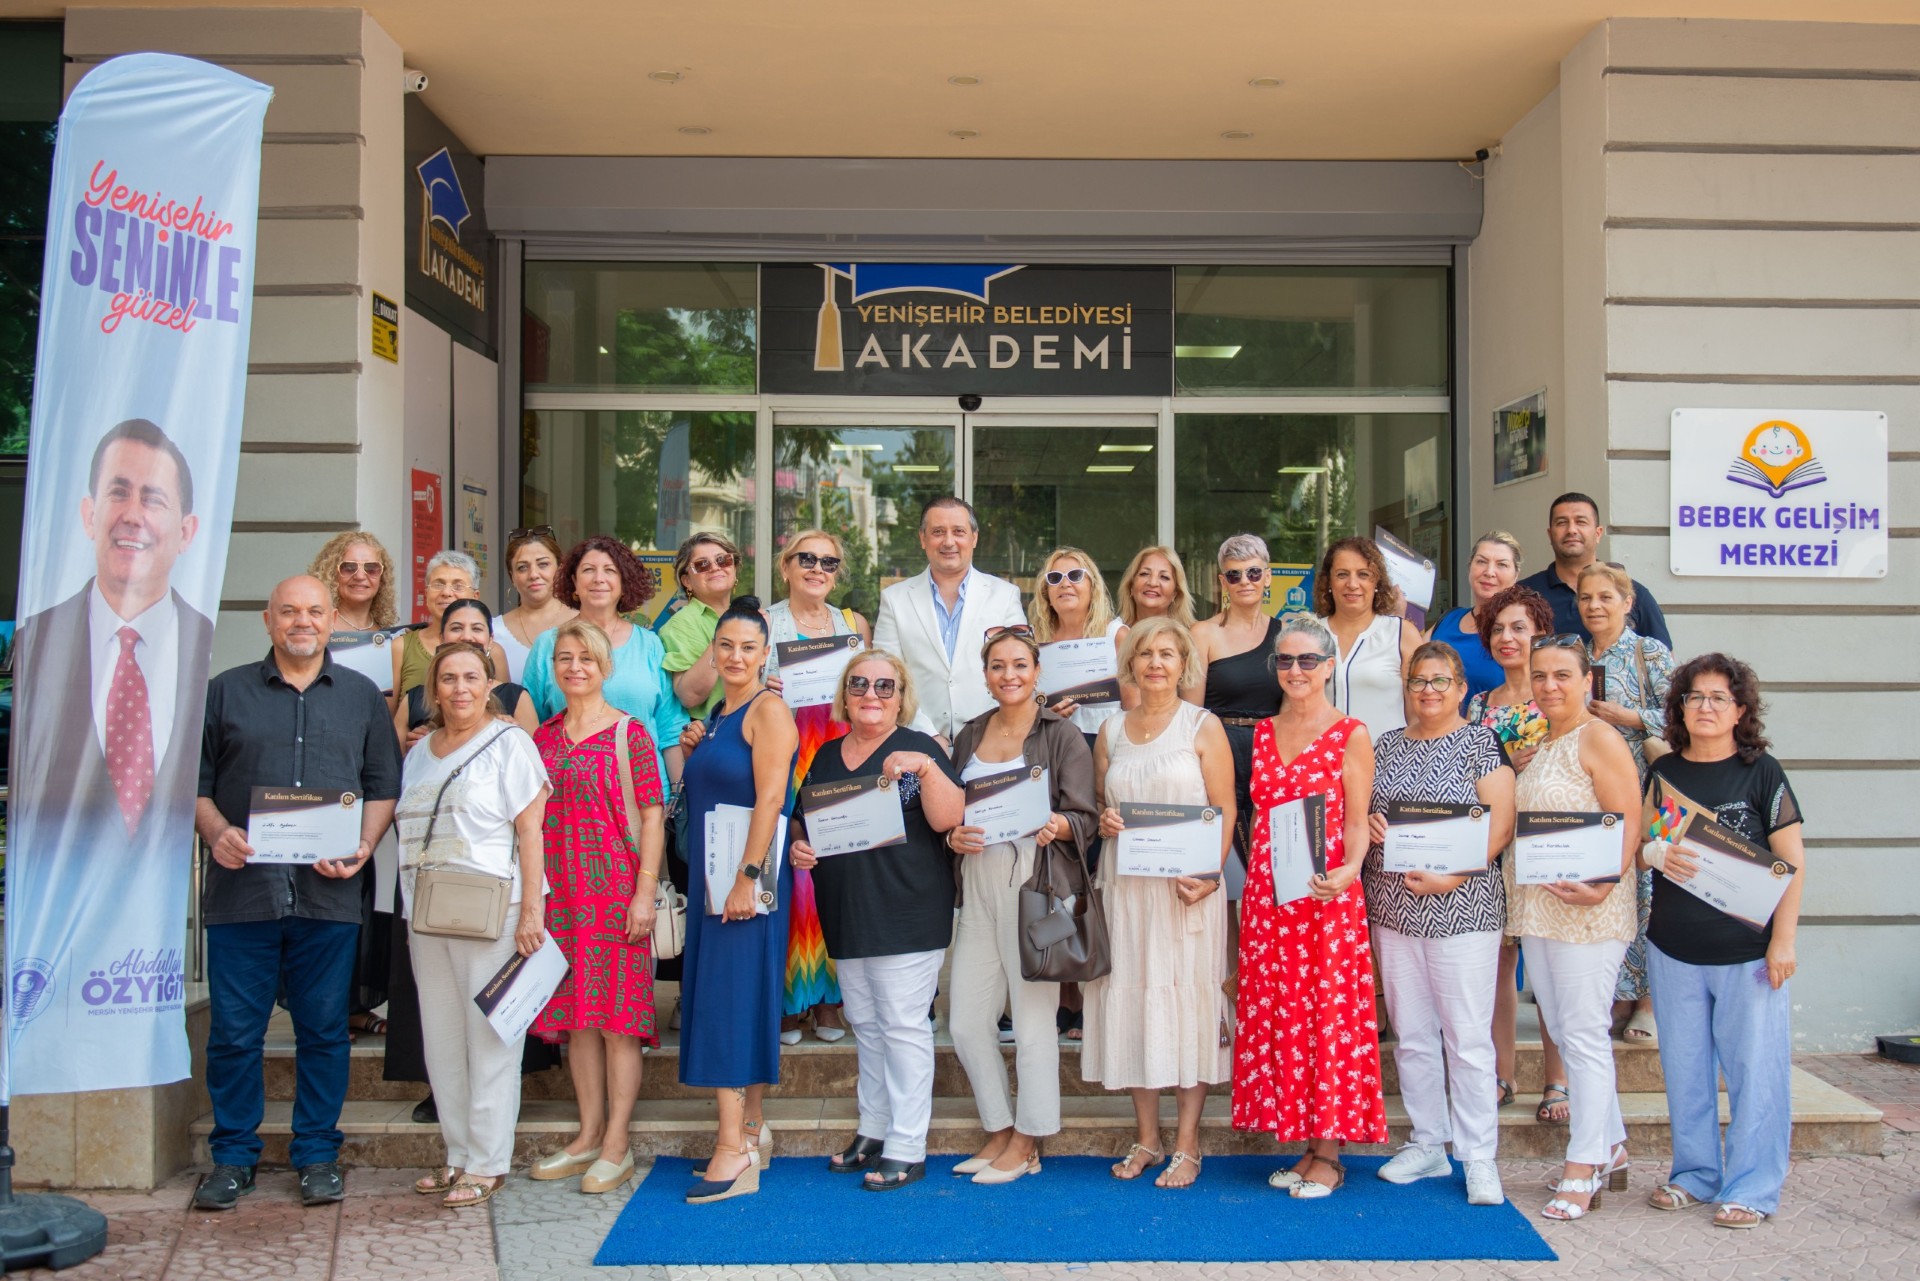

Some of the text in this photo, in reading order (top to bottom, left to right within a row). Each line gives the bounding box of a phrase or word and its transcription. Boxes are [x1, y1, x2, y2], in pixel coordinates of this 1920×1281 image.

[431, 249, 485, 312] AKADEMİ
[101, 289, 198, 334] güzel
[858, 302, 1132, 327] YENİŞEHİR BELEDİYESİ
[855, 327, 1132, 370] AKADEMİ
[1678, 502, 1880, 534] BEBEK GELİŞİM
[1720, 540, 1838, 566] MERKEZİ
[264, 792, 324, 802] Katılım Sertifikası
[811, 784, 863, 798] Katılım Sertifikası
[1131, 808, 1185, 818] Katılım Sertifikası
[1399, 806, 1453, 816] Katılım Sertifikası
[1529, 815, 1584, 824] Katılım Sertifikası
[1703, 824, 1757, 859] Katılım Sertifikası
[485, 977, 505, 999] Katılım
[88, 1007, 117, 1016] MERSİN
[117, 1006, 154, 1016] YENİŞEHİR
